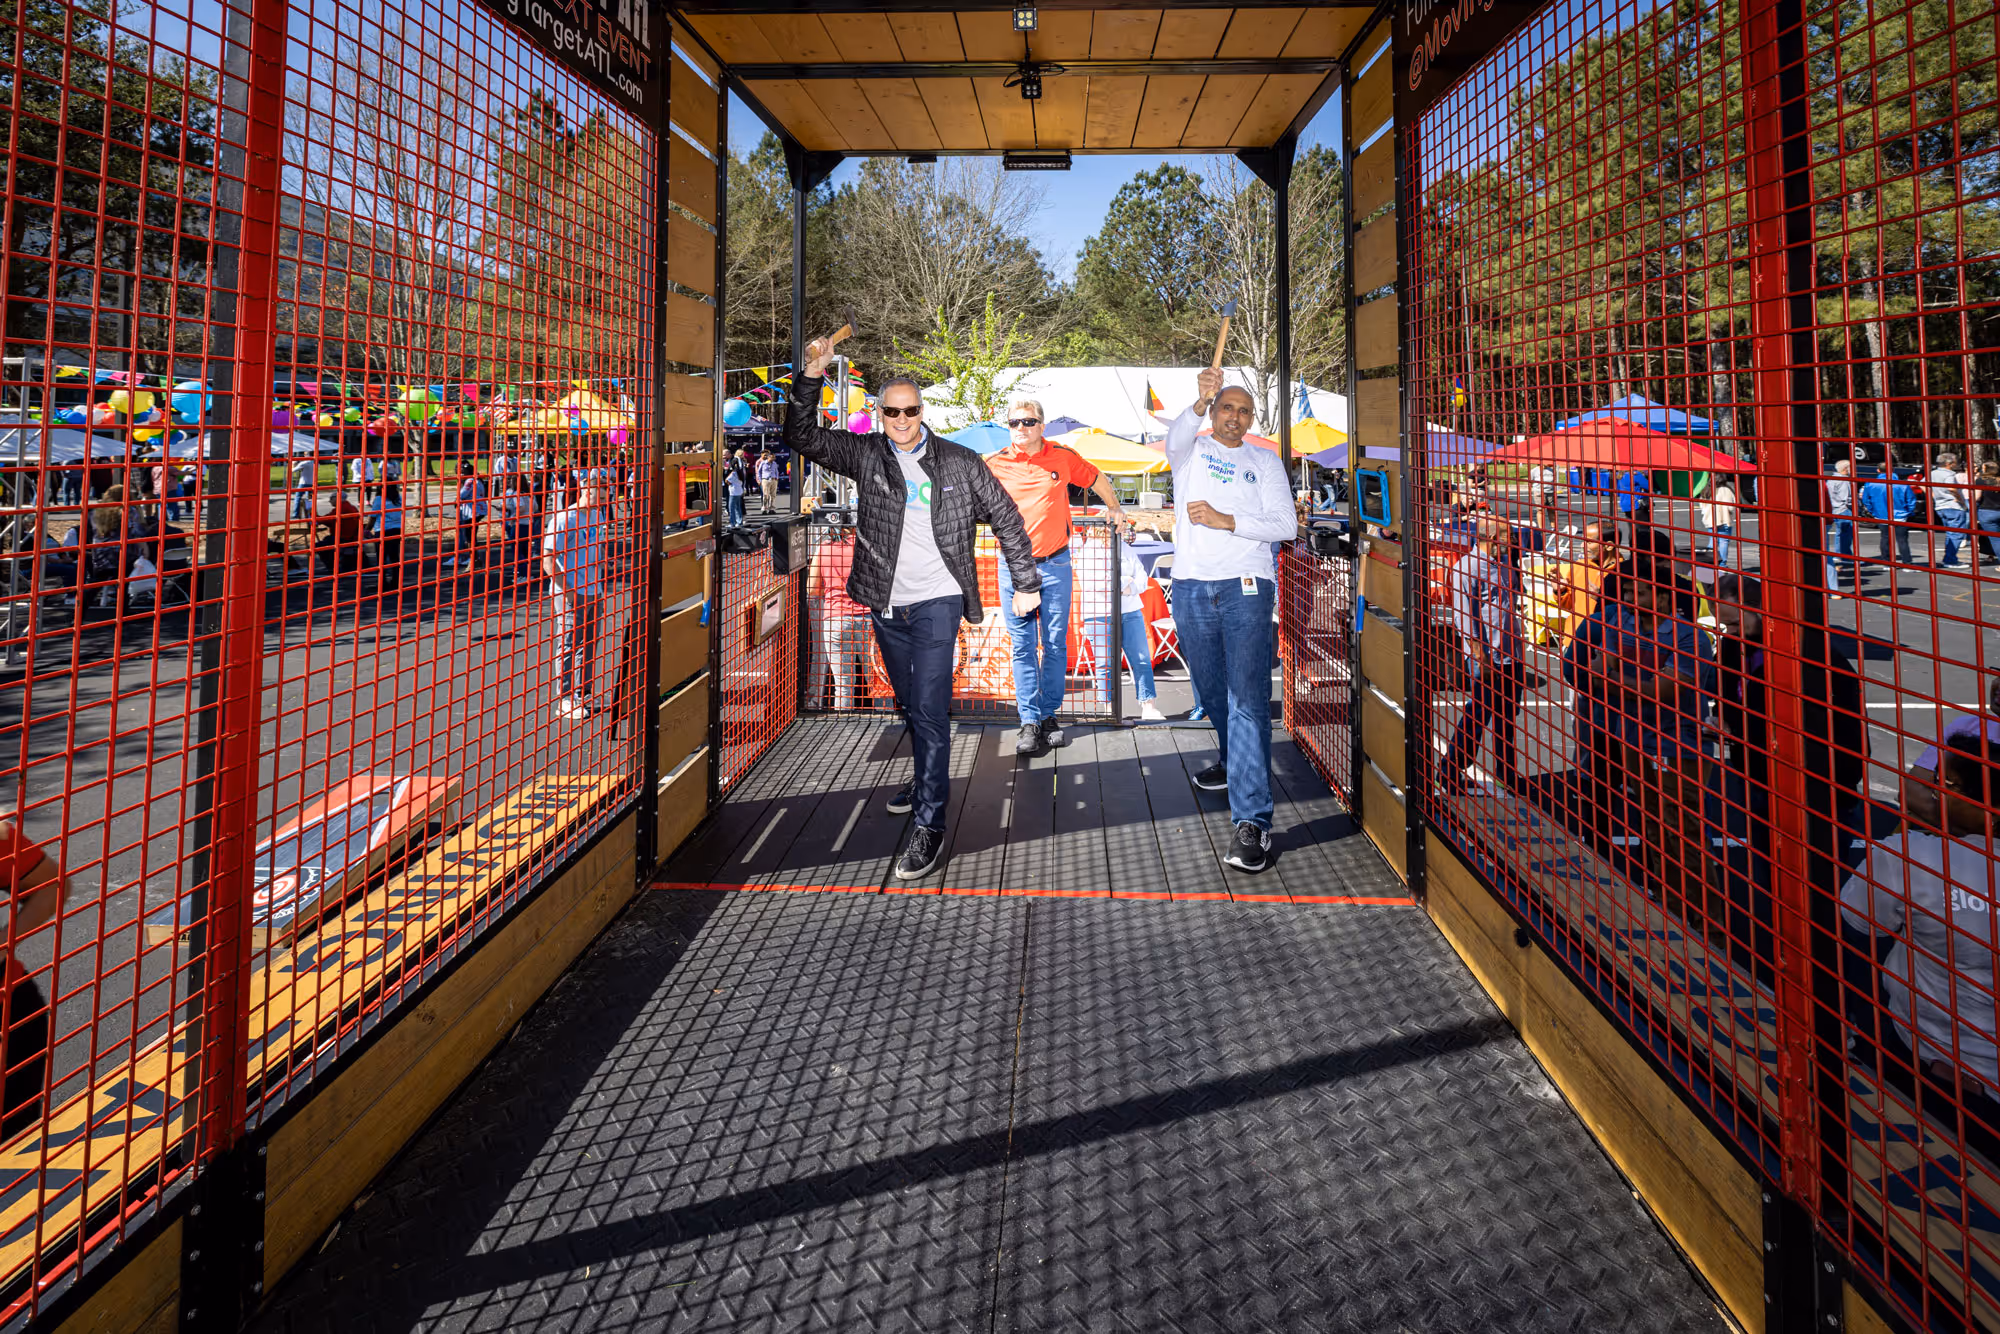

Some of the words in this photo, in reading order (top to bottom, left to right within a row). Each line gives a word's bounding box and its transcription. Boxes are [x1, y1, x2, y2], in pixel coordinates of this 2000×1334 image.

[554, 0, 593, 30] XT
[597, 13, 651, 81] EVENT
[1208, 464, 1235, 475] inspire
[1210, 472, 1233, 482] serve
